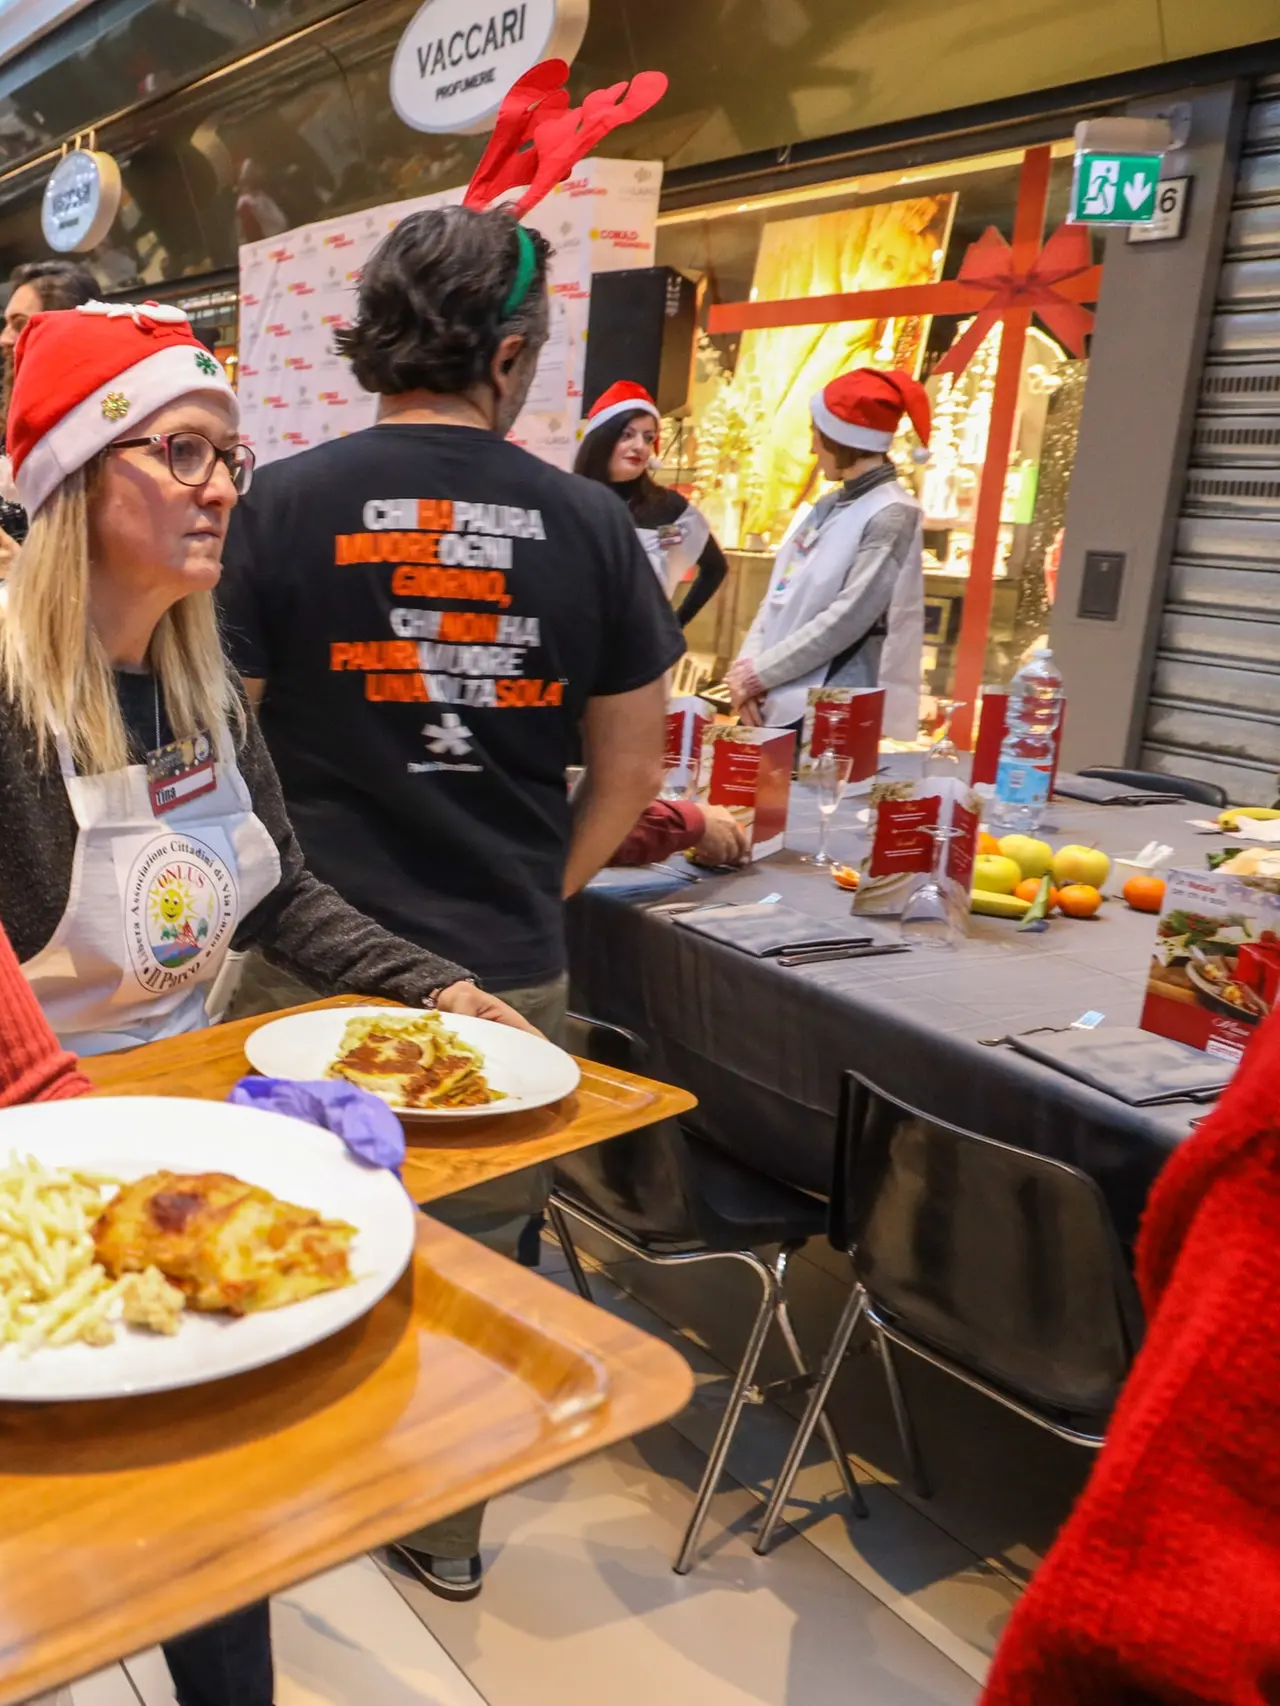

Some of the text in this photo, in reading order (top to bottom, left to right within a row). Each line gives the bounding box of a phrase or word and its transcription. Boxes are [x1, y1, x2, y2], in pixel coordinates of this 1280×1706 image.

[417, 3, 526, 78] VACCARI
[435, 67, 497, 101] PROFUMERIE
[363, 498, 418, 531] CHI
[453, 501, 546, 539] PAURA
[335, 531, 513, 569] MUORE OGNI
[389, 607, 541, 647] CHI NON HA
[417, 641, 528, 676] MUORE
[494, 679, 564, 708] SOLA
[131, 845, 168, 916] Associazione
[169, 840, 214, 868] Cittadini
[213, 868, 225, 882] di
[221, 883, 232, 907] Via
[156, 864, 206, 888] ONLUS
[145, 966, 163, 988] Il
